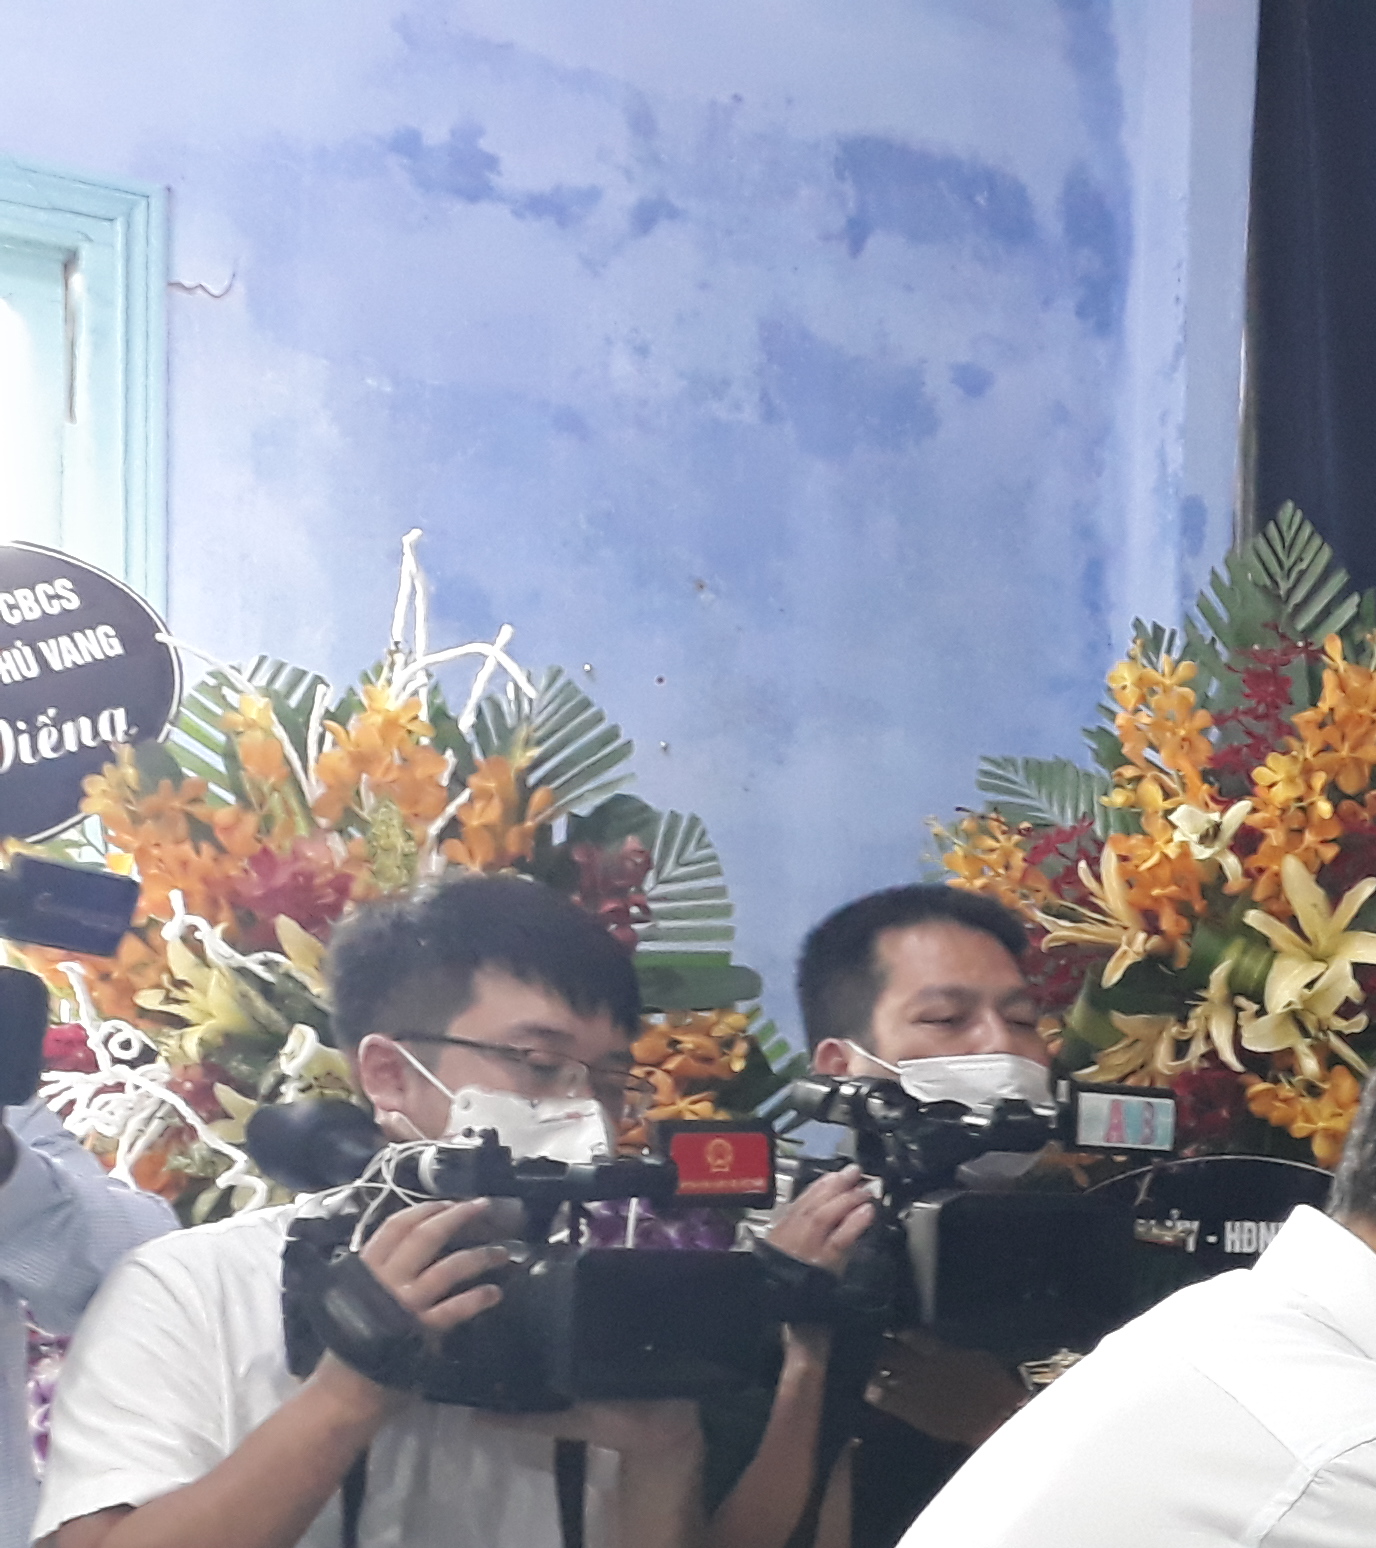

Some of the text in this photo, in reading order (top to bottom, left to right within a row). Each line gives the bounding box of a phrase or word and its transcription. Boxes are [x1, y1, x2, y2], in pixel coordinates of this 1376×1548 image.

[0, 577, 81, 626] CBCS
[0, 624, 125, 685] HÚ VANG
